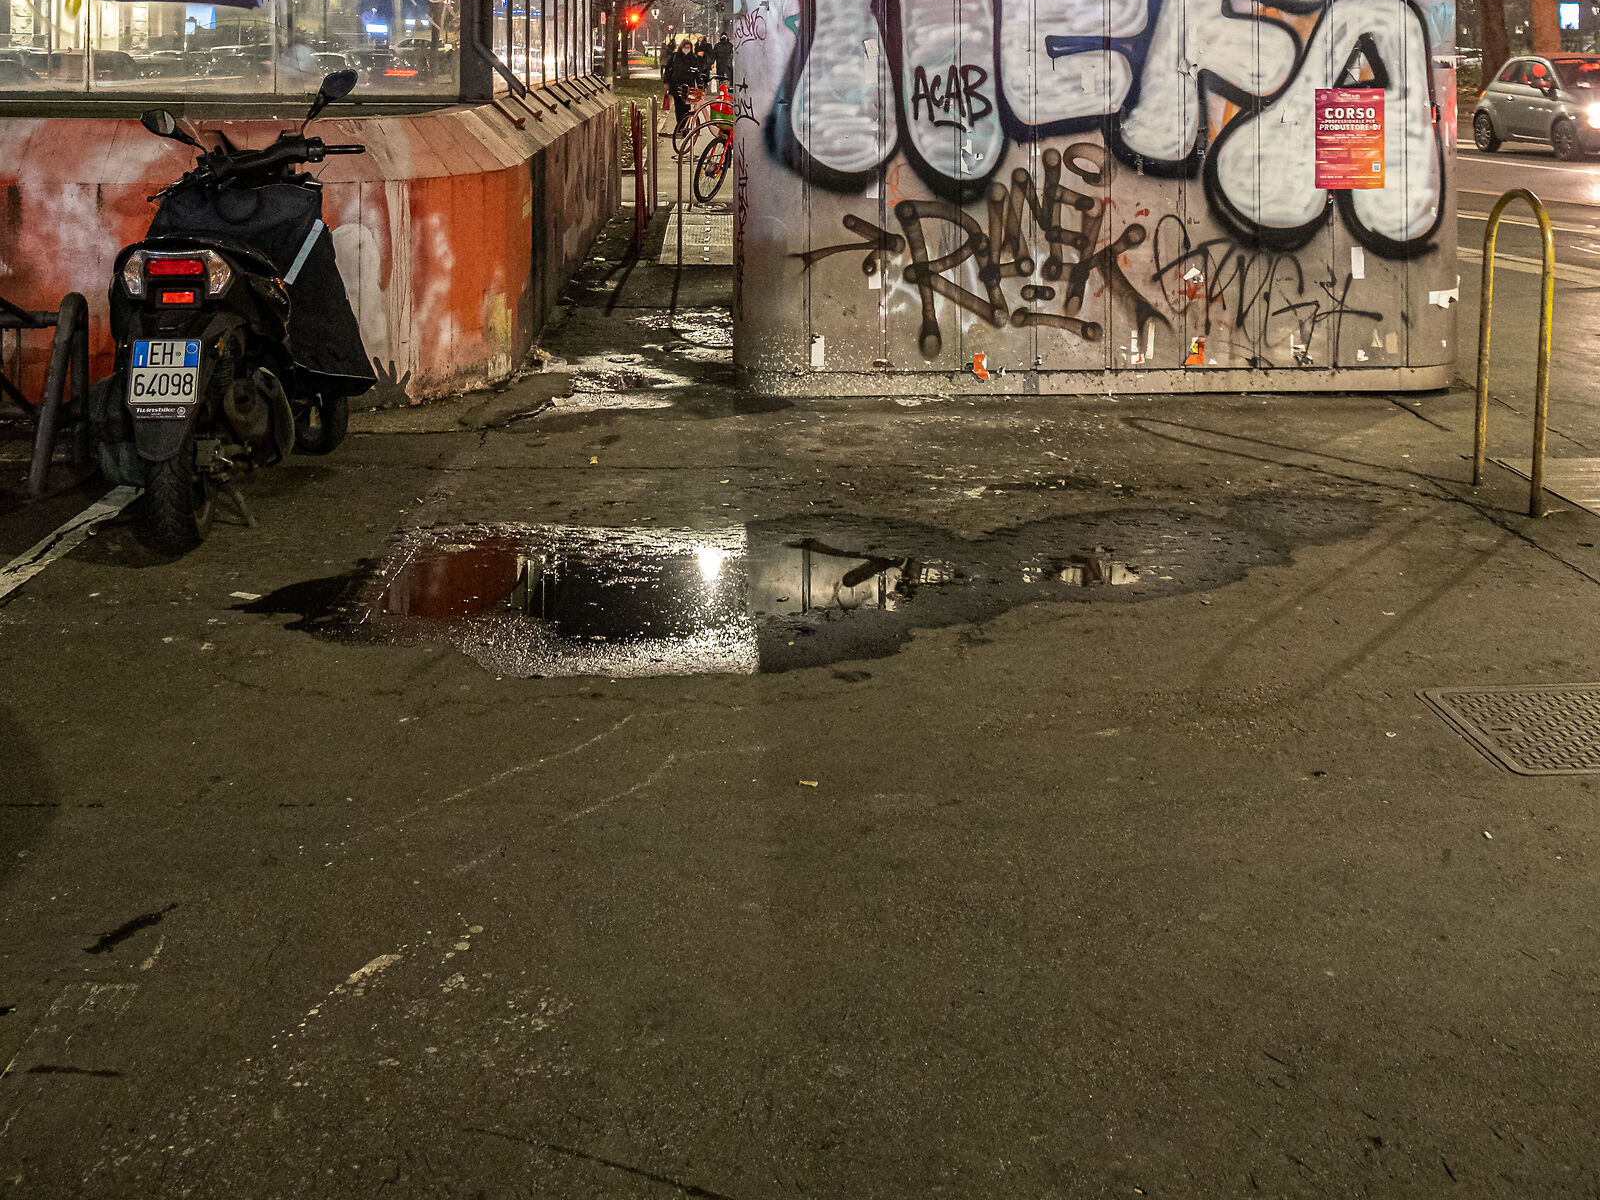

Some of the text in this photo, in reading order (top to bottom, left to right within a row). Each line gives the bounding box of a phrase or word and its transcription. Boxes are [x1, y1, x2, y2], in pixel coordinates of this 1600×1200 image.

[1324, 107, 1376, 119] CORSO
[149, 342, 175, 366] EH
[133, 373, 194, 397] 64098
